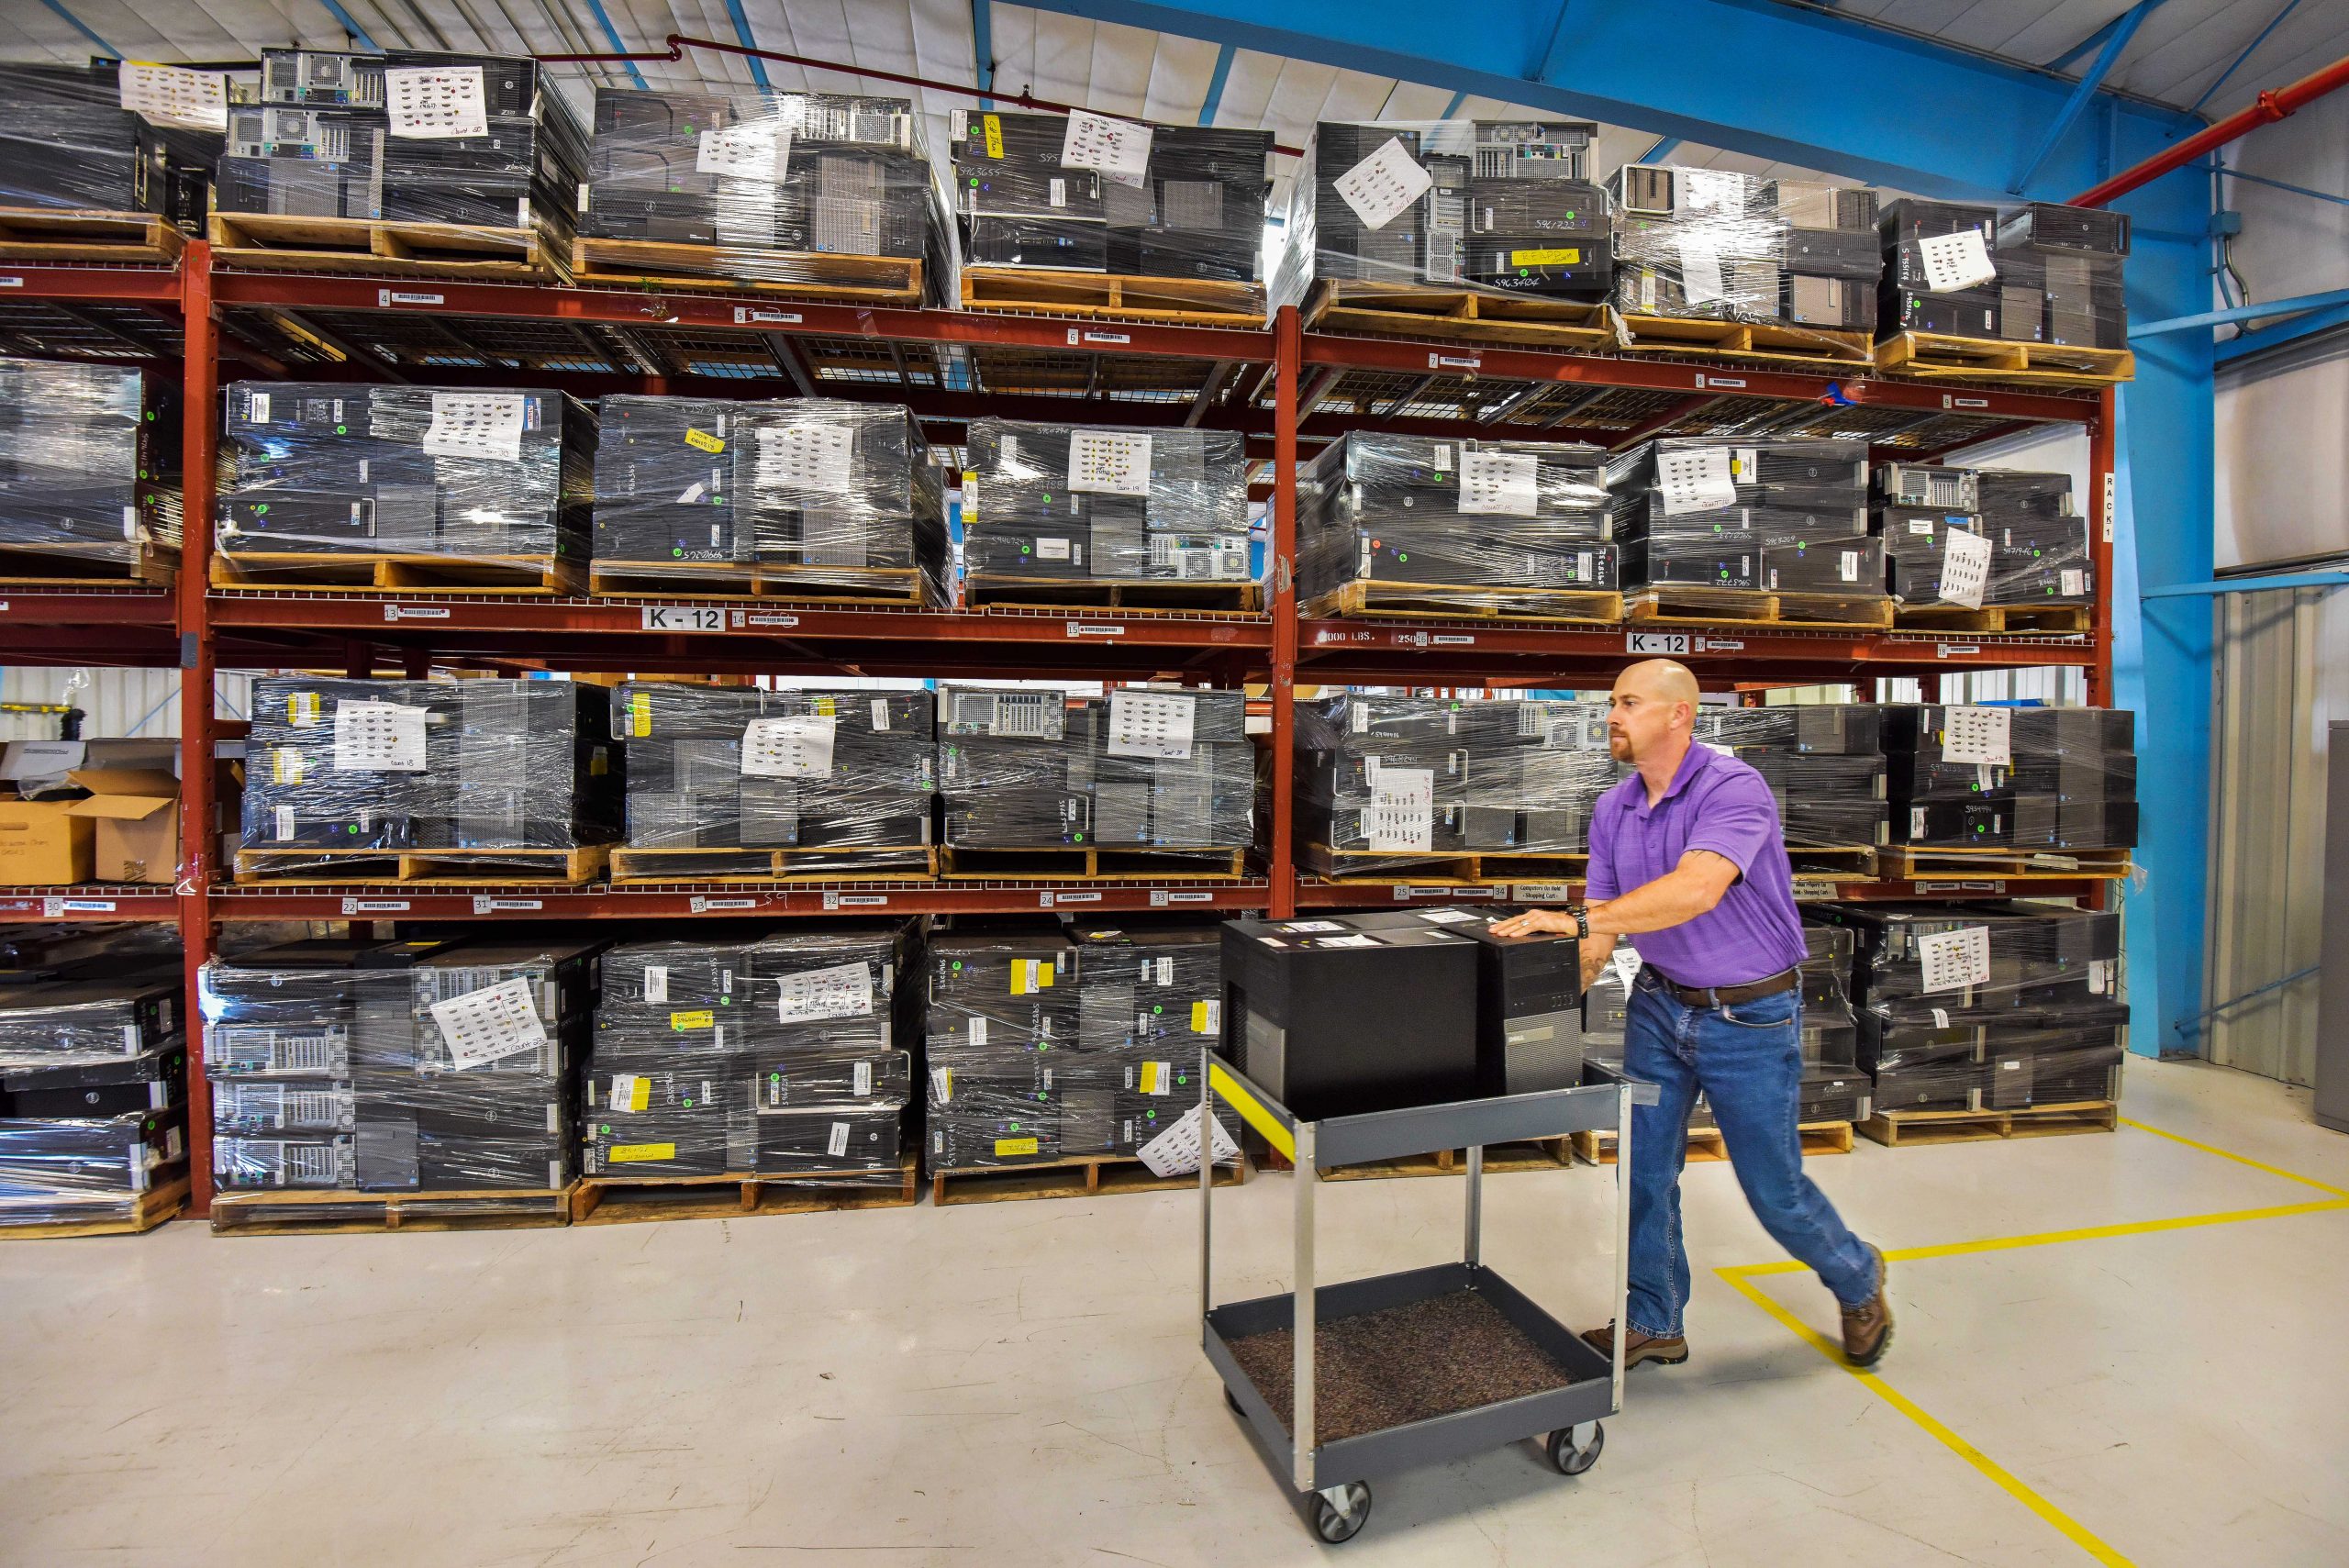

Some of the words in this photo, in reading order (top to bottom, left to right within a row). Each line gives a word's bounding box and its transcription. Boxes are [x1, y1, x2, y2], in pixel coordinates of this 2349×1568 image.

[382, 295, 387, 304] 4
[737, 312, 743, 321] 5
[1070, 333, 1075, 342] 6
[1431, 357, 1436, 365] 7
[1698, 377, 1703, 385] 8
[1944, 398, 1950, 406] 9
[385, 609, 396, 618] 13
[651, 609, 667, 628] K
[692, 609, 718, 628] 12
[733, 616, 743, 624] 14
[1068, 626, 1078, 635] 15
[1418, 635, 1426, 643] 16
[1633, 635, 1645, 651] K
[1664, 636, 1684, 651] 12
[1696, 641, 1704, 650] 17
[1938, 648, 1946, 656] 18
[1917, 883, 1925, 891] 27
[1397, 888, 1407, 896] 25
[826, 895, 837, 905] 32
[1041, 896, 1052, 905] 24
[1155, 894, 1164, 902] 33
[47, 902, 60, 911] 30
[343, 903, 355, 912] 22
[475, 899, 486, 908] 31
[693, 901, 705, 910] 23
[510, 1041, 532, 1052] Count
[532, 1037, 545, 1045] 23
